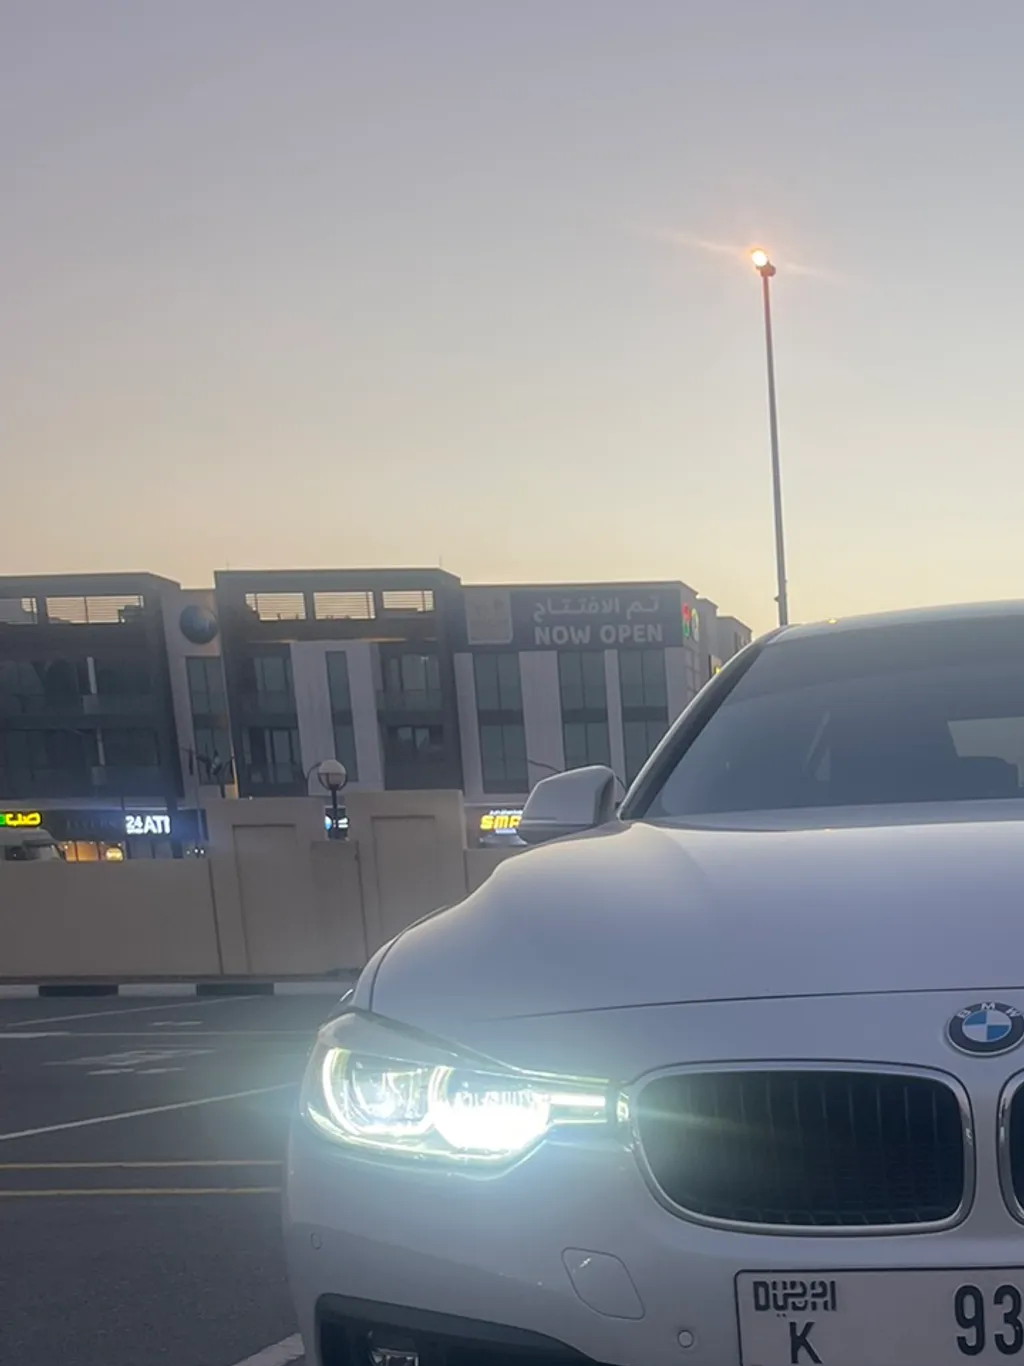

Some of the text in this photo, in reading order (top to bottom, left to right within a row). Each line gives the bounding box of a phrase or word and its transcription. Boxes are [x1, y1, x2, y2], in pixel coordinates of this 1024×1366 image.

[533, 597, 660, 623] تم الافتتاح
[534, 623, 663, 645] NOW OPEN
[957, 1002, 1021, 1019] BMW
[789, 1321, 823, 1364] K
